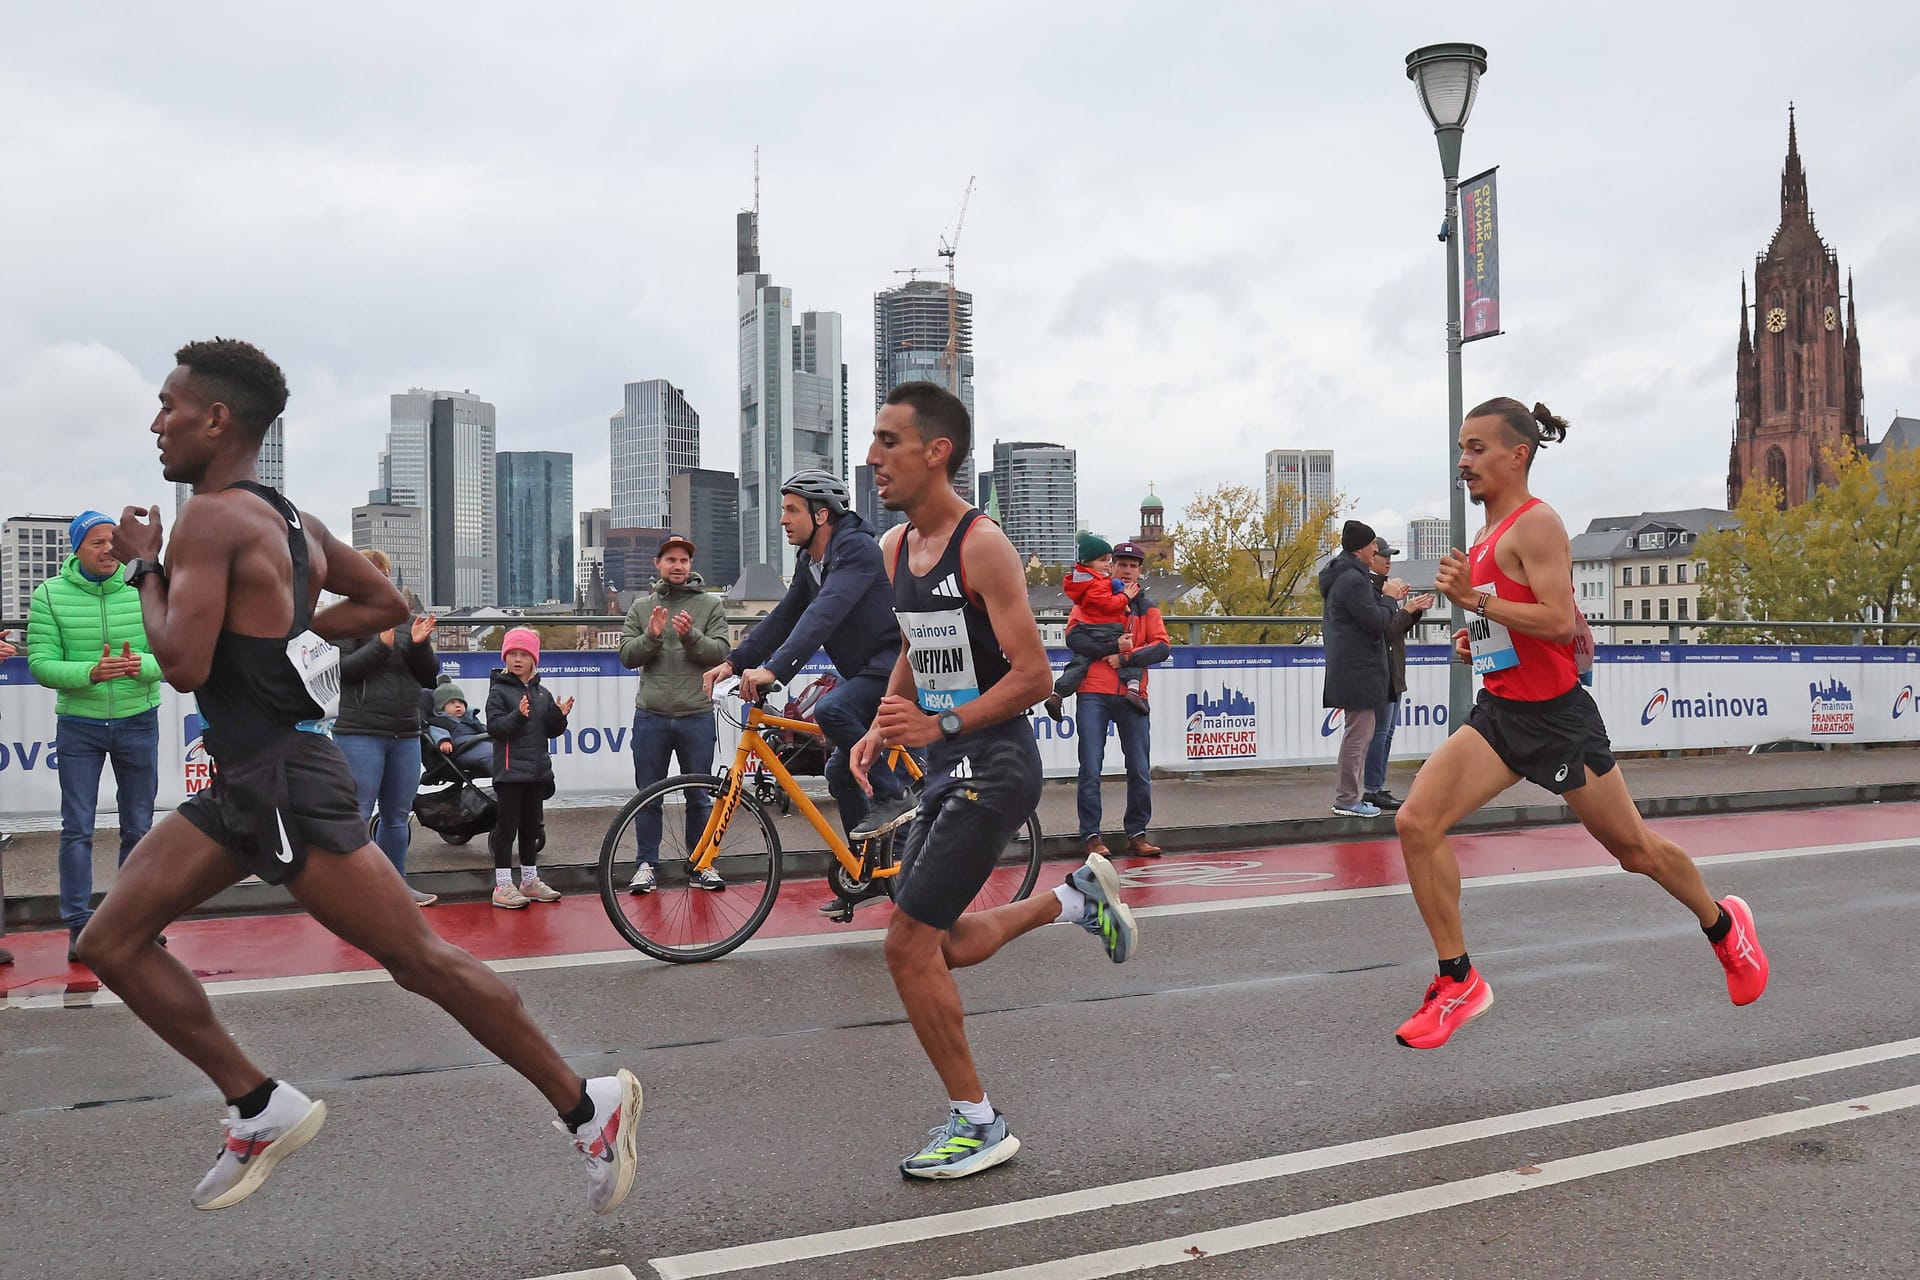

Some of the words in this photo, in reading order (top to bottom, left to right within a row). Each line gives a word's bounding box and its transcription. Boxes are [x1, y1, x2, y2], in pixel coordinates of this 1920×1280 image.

[929, 680, 937, 691] 12
[925, 694, 956, 711] HOKA
[1671, 692, 1769, 719] mainova
[1822, 700, 1854, 712] mainova
[1203, 715, 1256, 729] mainova
[1811, 712, 1854, 724] FRANKFURT
[1811, 722, 1855, 734] MARATHON
[549, 727, 627, 755] nov
[1185, 730, 1256, 745] FRANKFURT
[1187, 743, 1256, 757] MARATHON
